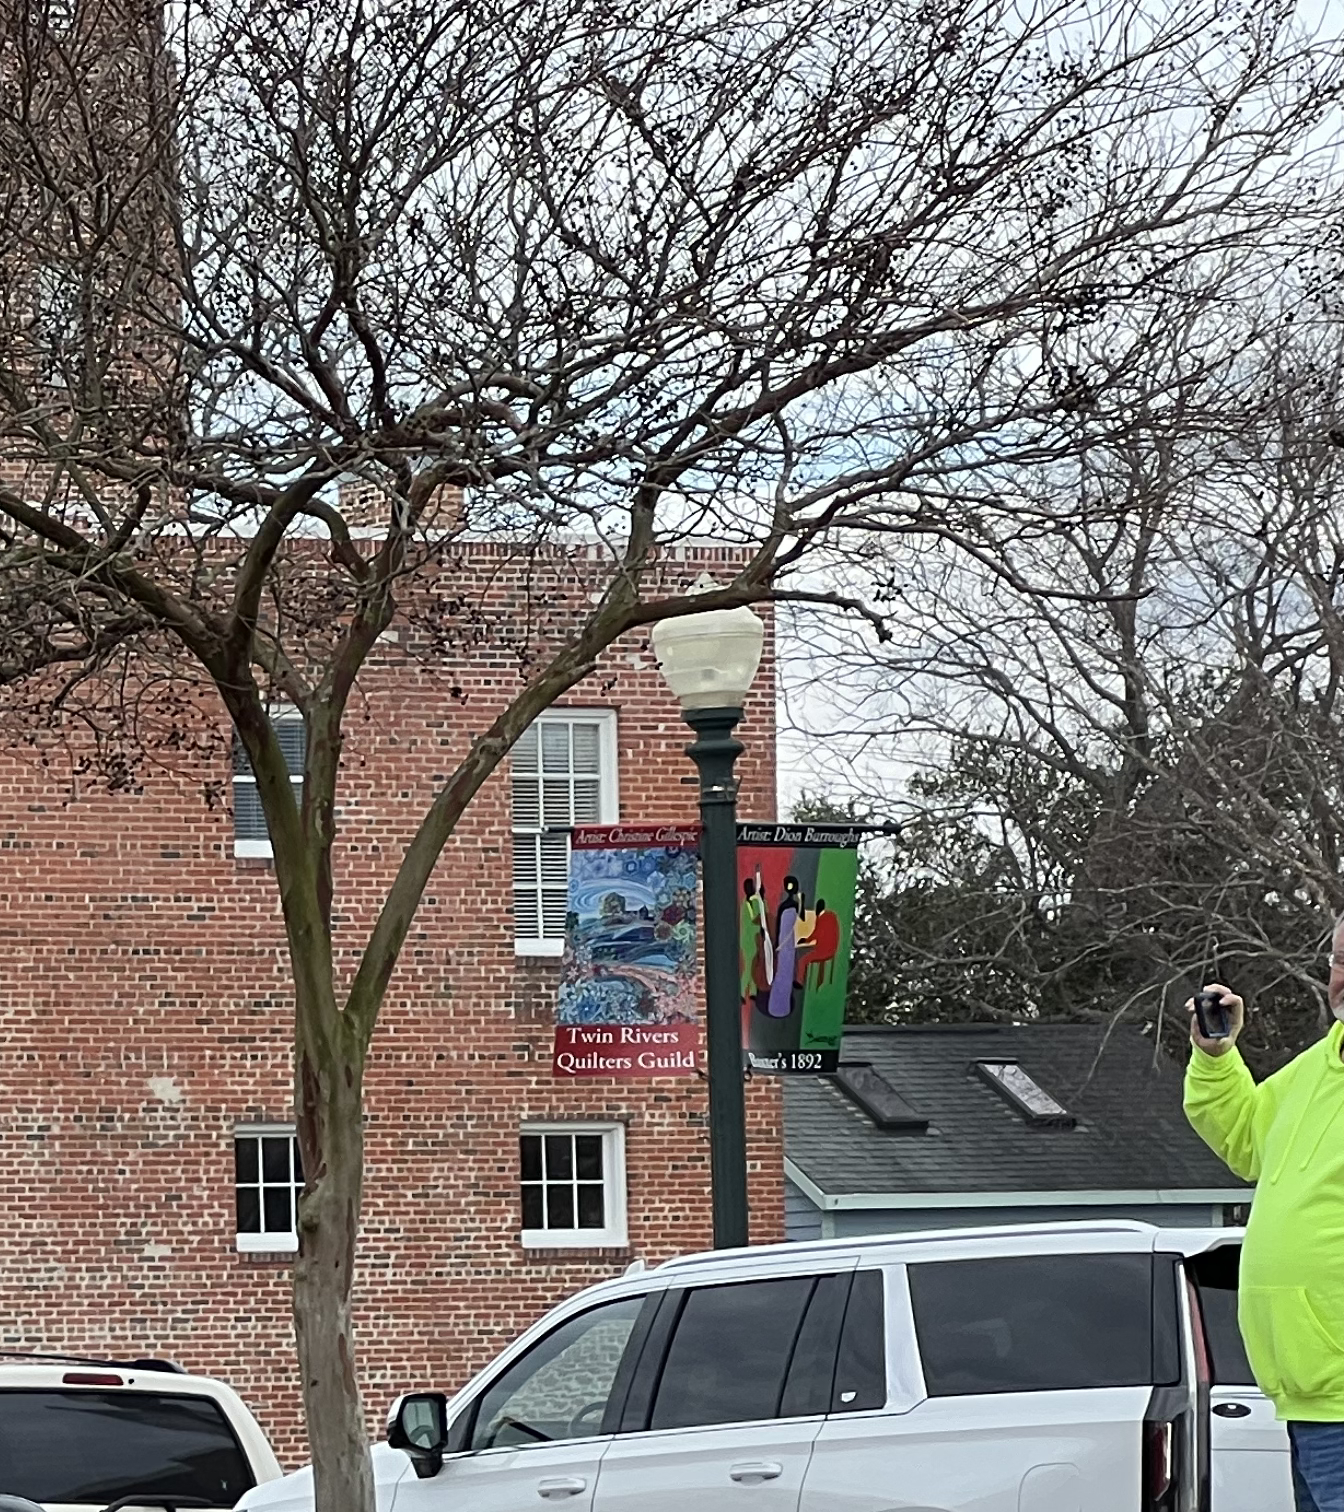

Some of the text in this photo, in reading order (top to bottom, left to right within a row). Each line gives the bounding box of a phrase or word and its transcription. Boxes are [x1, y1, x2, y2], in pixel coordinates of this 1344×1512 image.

[774, 826, 802, 842] Dion
[566, 1027, 679, 1044] Twin Rivers
[557, 1050, 695, 1074] Quilters Guild
[791, 1053, 822, 1069] 1892
